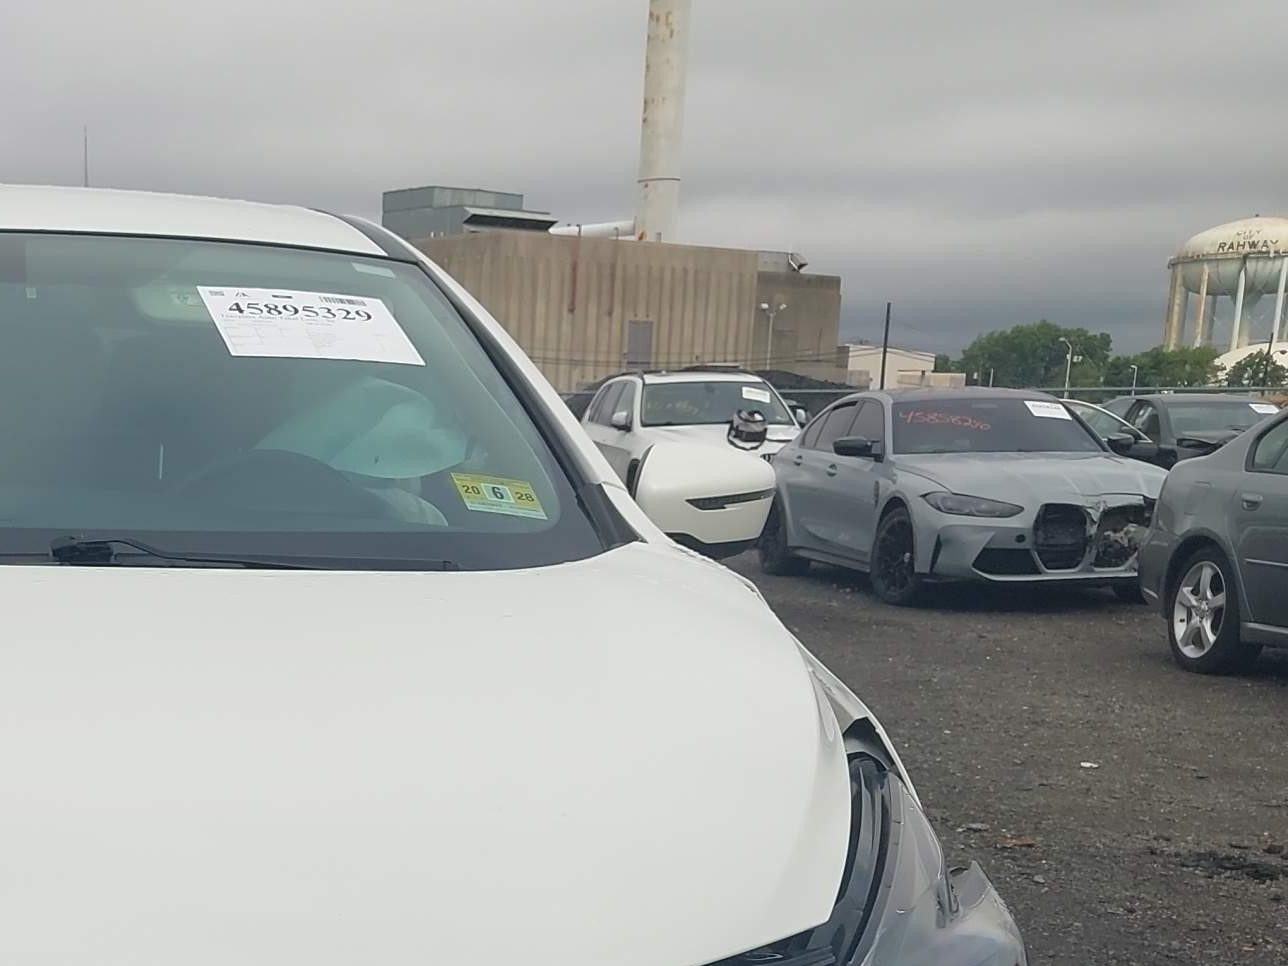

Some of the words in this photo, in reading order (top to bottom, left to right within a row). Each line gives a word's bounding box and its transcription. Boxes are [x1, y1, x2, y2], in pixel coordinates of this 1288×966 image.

[1217, 239, 1280, 252] RAHWAY
[228, 301, 373, 322] 45895329
[462, 484, 481, 495] 20
[491, 486, 505, 500] 6
[515, 491, 535, 502] 28
